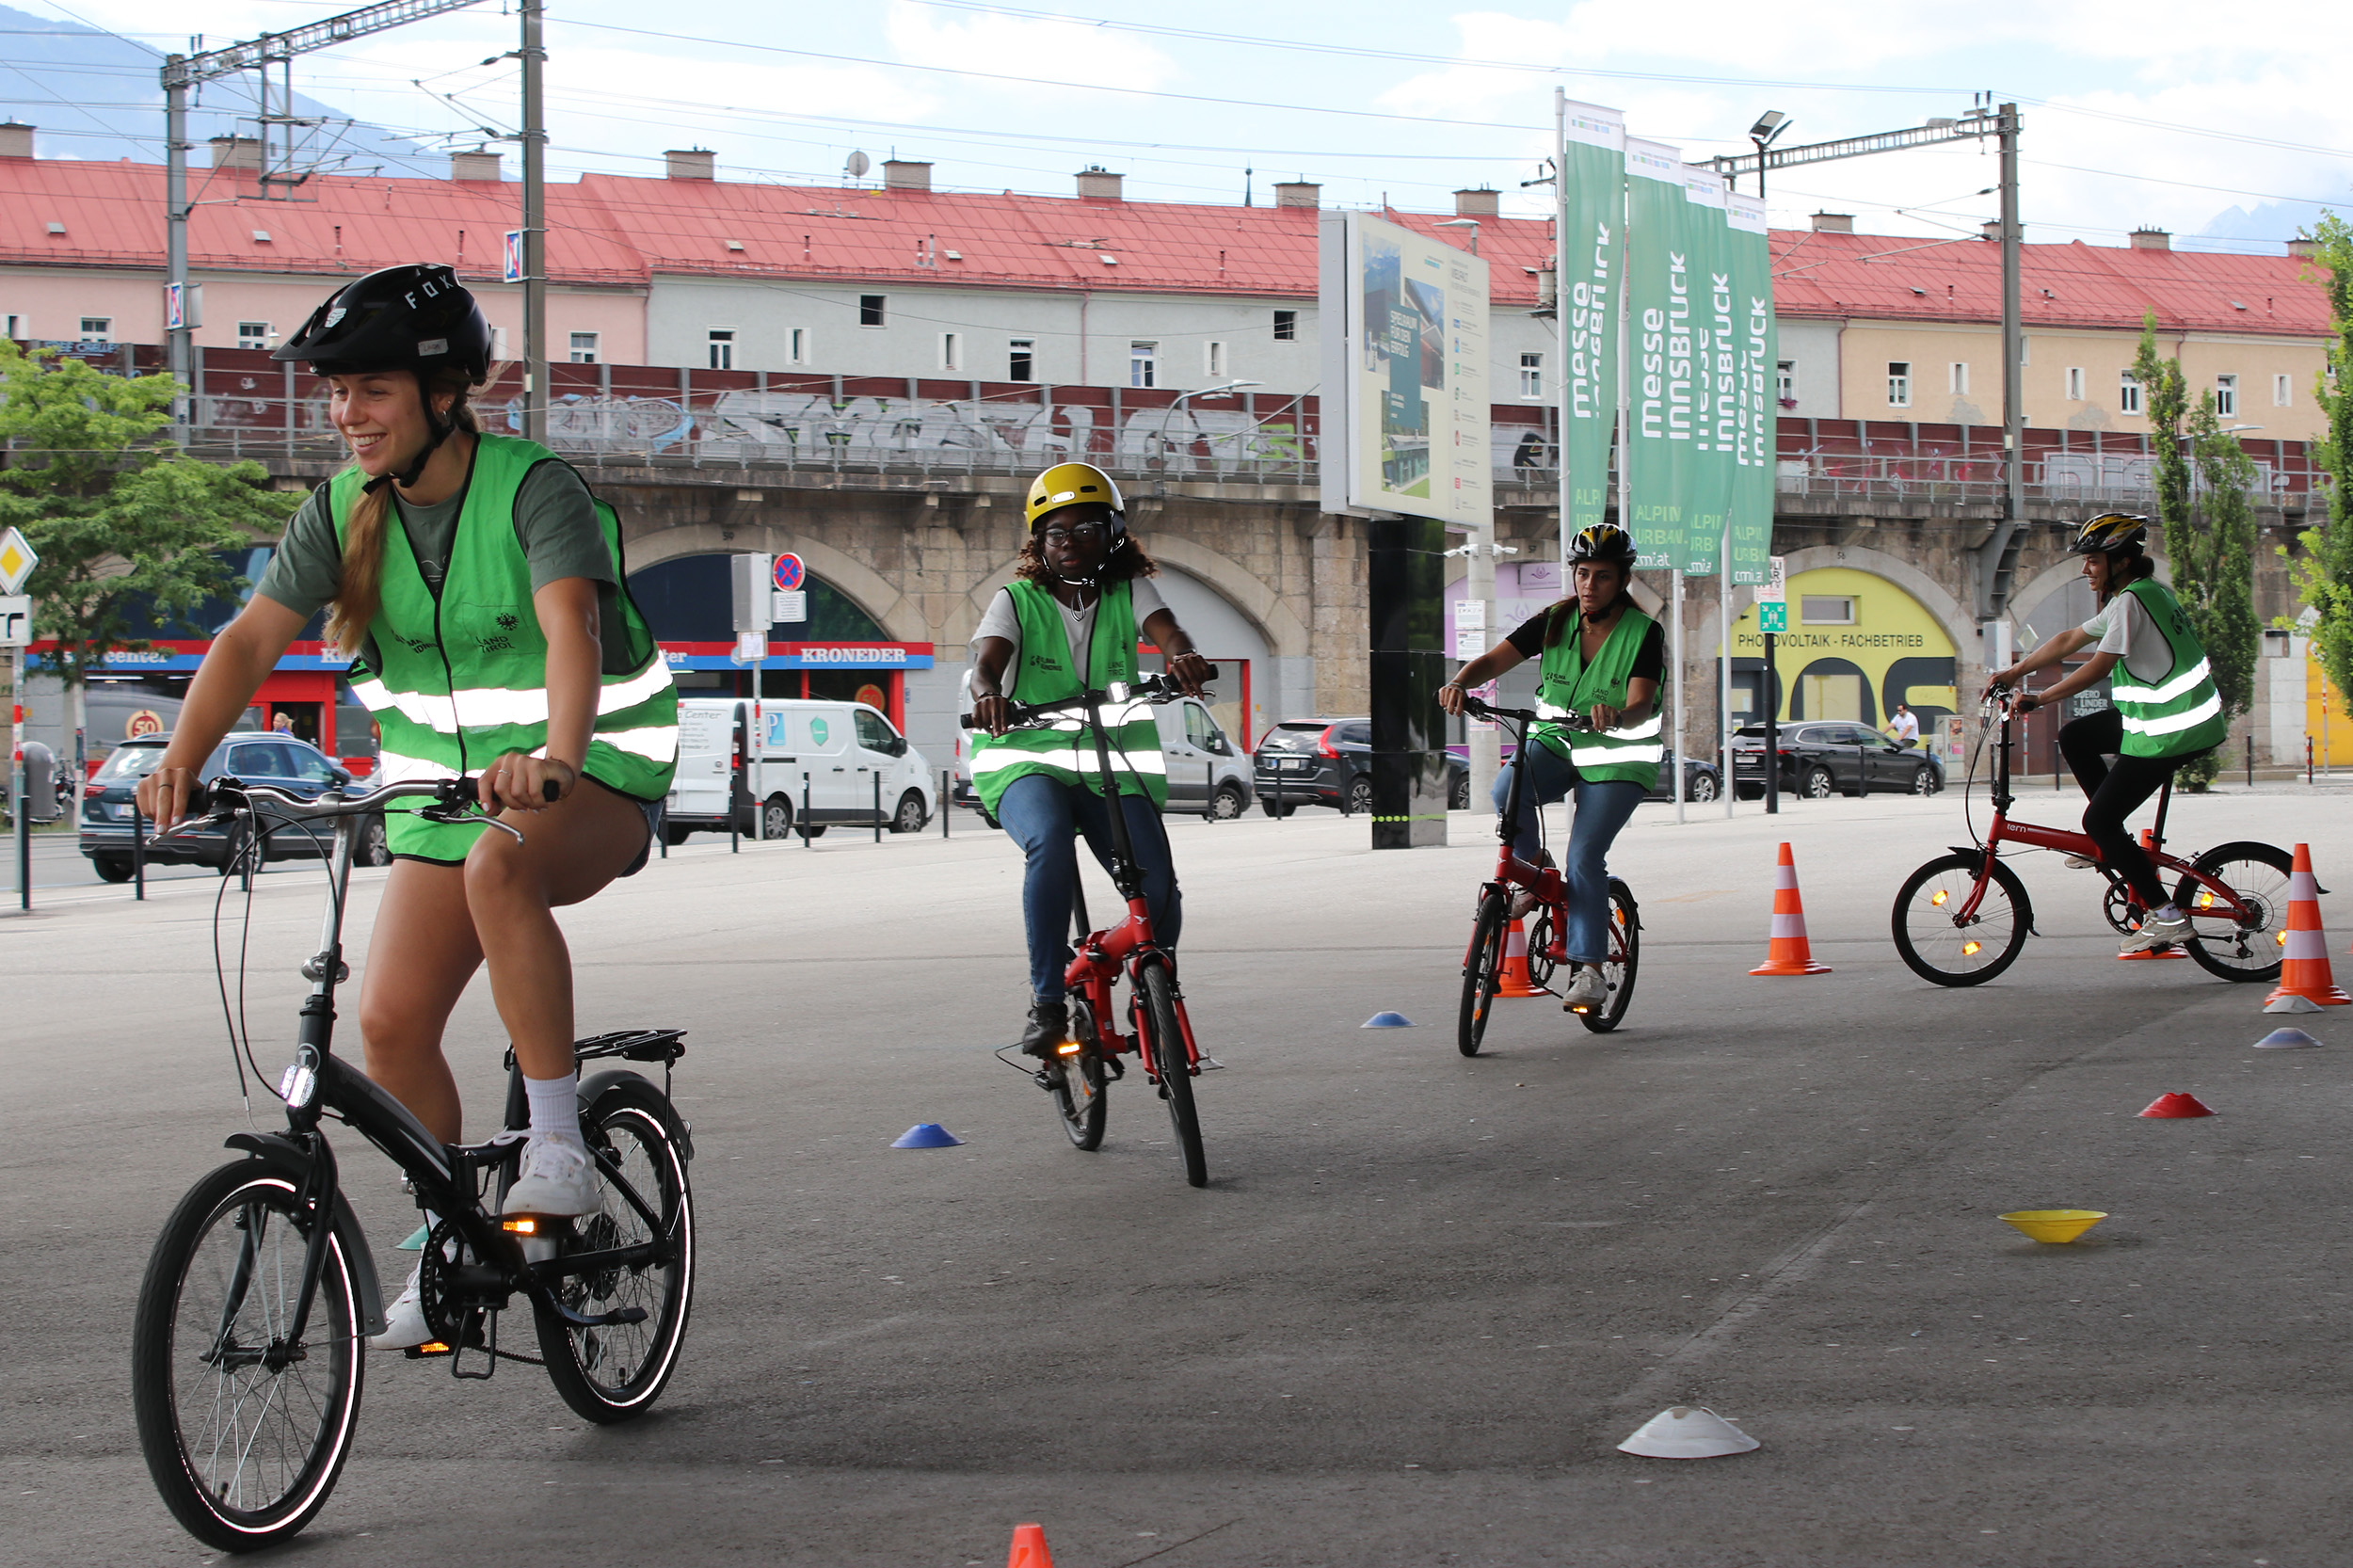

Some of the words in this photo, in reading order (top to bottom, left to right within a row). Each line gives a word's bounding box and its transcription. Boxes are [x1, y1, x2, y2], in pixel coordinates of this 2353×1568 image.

[405, 275, 454, 309] FOX
[1572, 281, 1592, 418] messe
[1641, 308, 1664, 438] messe
[1635, 504, 1682, 521] ALPIN
[479, 642, 515, 653] TIROL
[1738, 634, 1830, 648] PHOOVOLTAIK
[1841, 634, 1923, 648] FACHBETRIEB
[104, 650, 168, 663] center
[800, 648, 906, 663] KRONEDER
[1591, 693, 1608, 702] TIROL
[1593, 687, 1609, 696] LAND
[2080, 698, 2107, 707] LINDER
[134, 719, 154, 733] 50
[2007, 824, 2026, 833] tern
